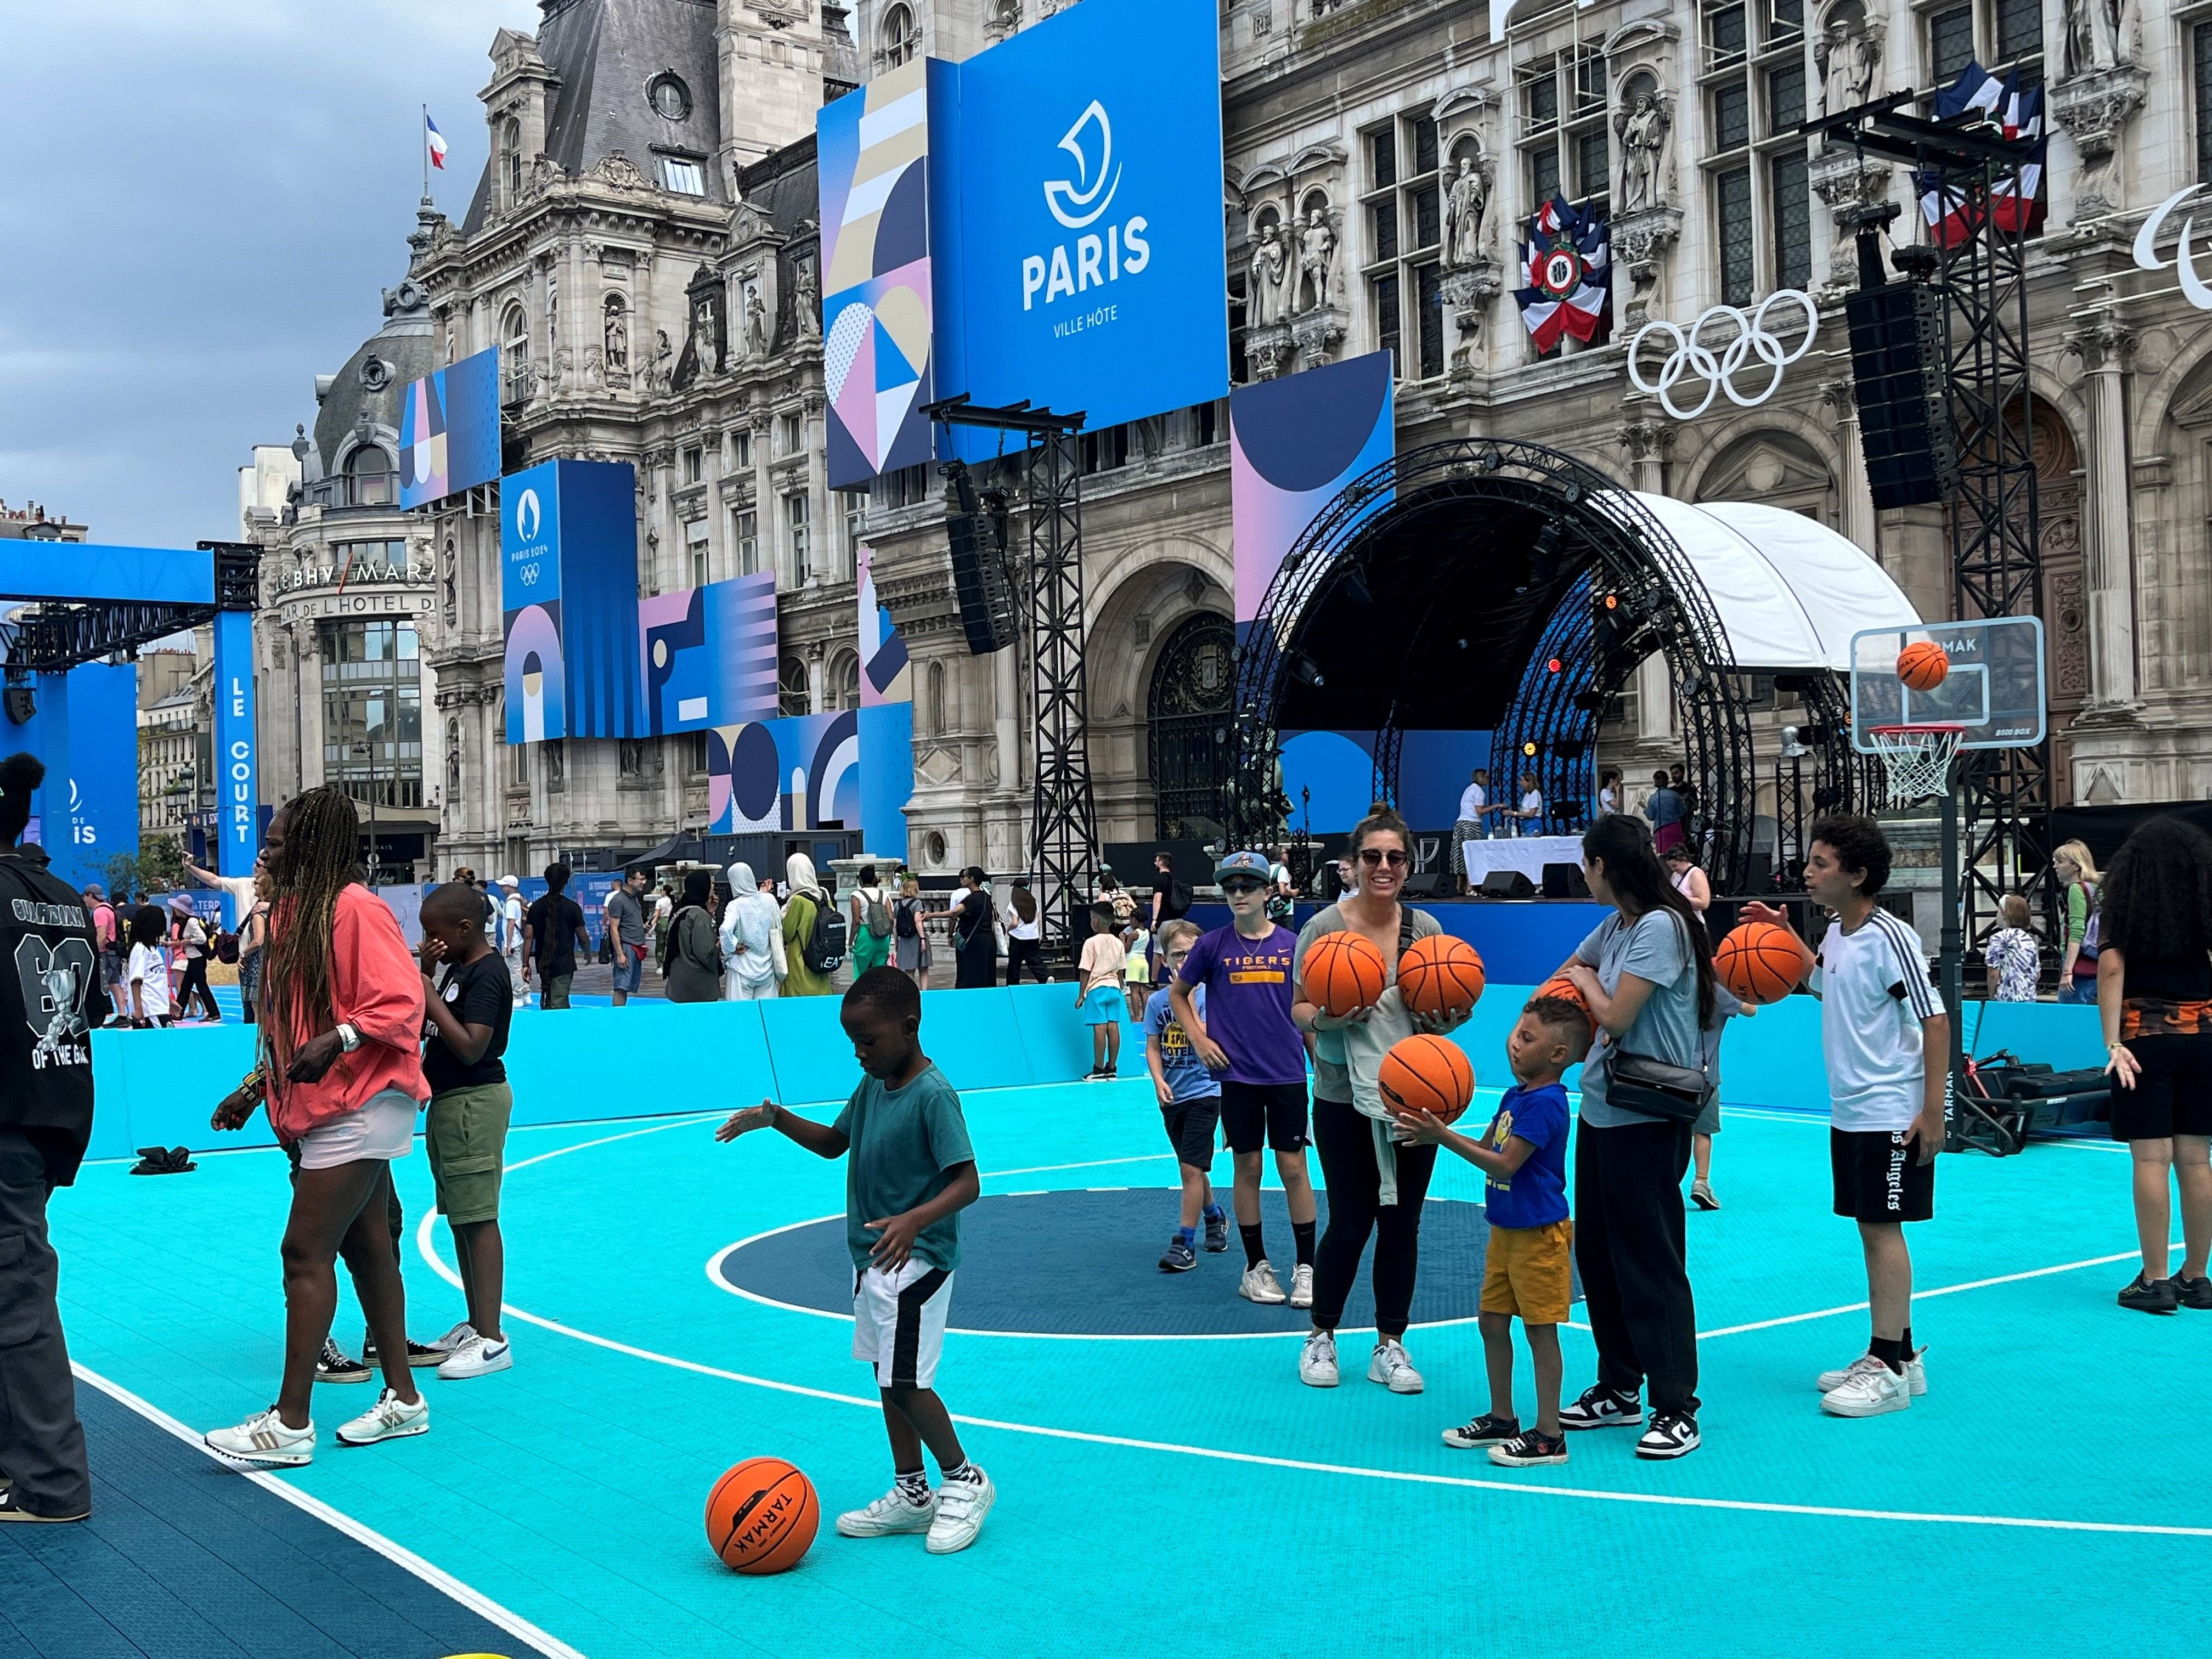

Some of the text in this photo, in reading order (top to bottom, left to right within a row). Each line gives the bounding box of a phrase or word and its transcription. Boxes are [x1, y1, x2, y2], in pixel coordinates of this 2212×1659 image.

[1023, 216, 1150, 312] PARIS
[1054, 304, 1118, 338] VILLE HÔTE
[511, 544, 548, 563] PARIS 2024
[294, 566, 334, 588] BHV
[303, 603, 317, 617] DE
[422, 598, 436, 610] D
[1937, 638, 1976, 653] MAK
[233, 678, 245, 717] LE
[2014, 727, 2031, 736] BOX
[231, 741, 251, 843] COURT
[1223, 956, 1291, 967] TIGERS
[1161, 1046, 1194, 1057] HOTEL
[1886, 1149, 1908, 1211] Angeles
[733, 1493, 793, 1554] TARMAK
